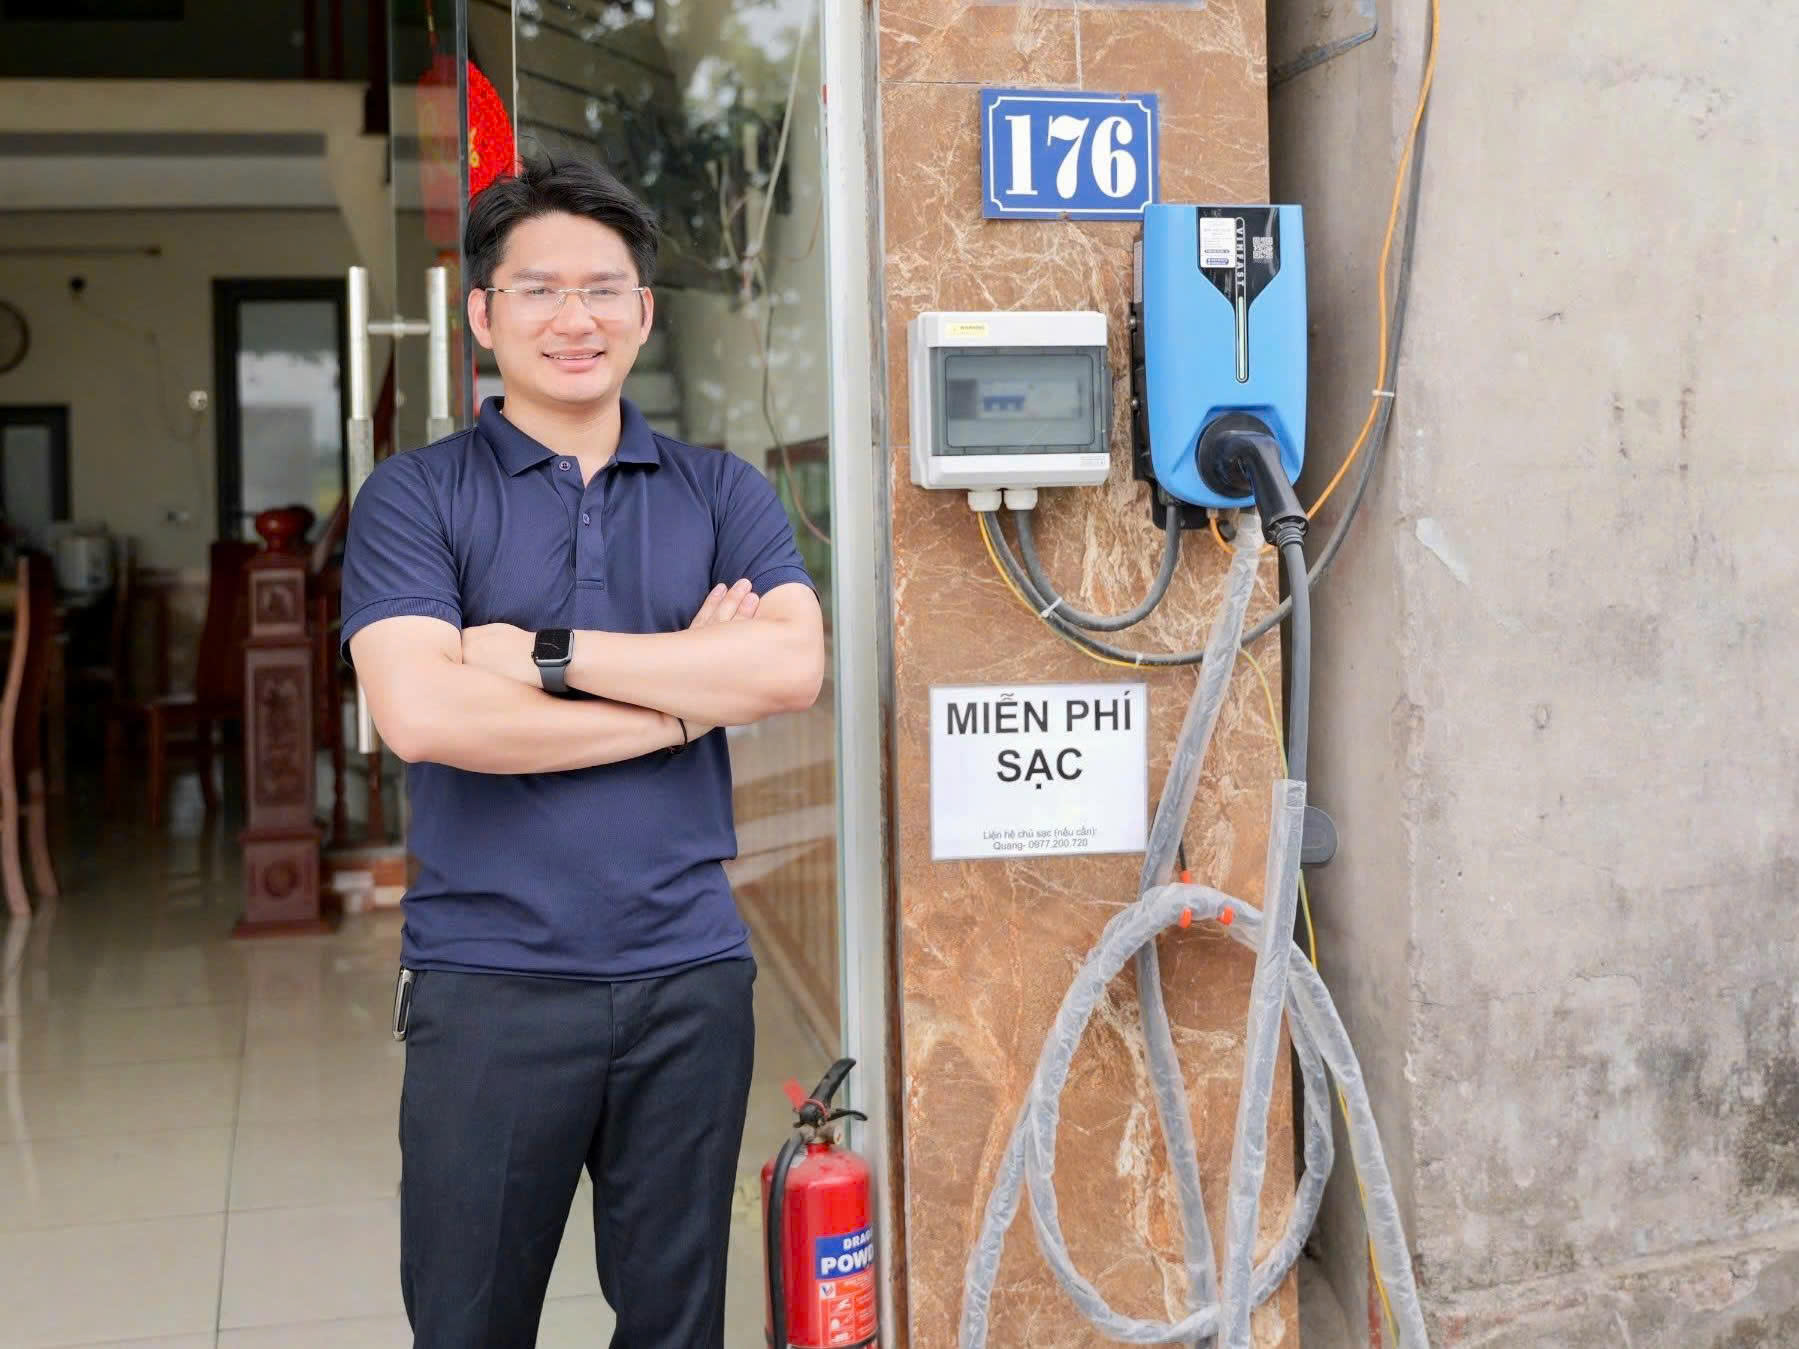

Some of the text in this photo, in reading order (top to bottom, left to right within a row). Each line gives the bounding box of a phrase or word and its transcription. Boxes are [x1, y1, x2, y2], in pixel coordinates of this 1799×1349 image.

[1005, 114, 1136, 199] 176
[947, 690, 1131, 735] MIỄN PHÍ
[997, 747, 1082, 790] SẠC
